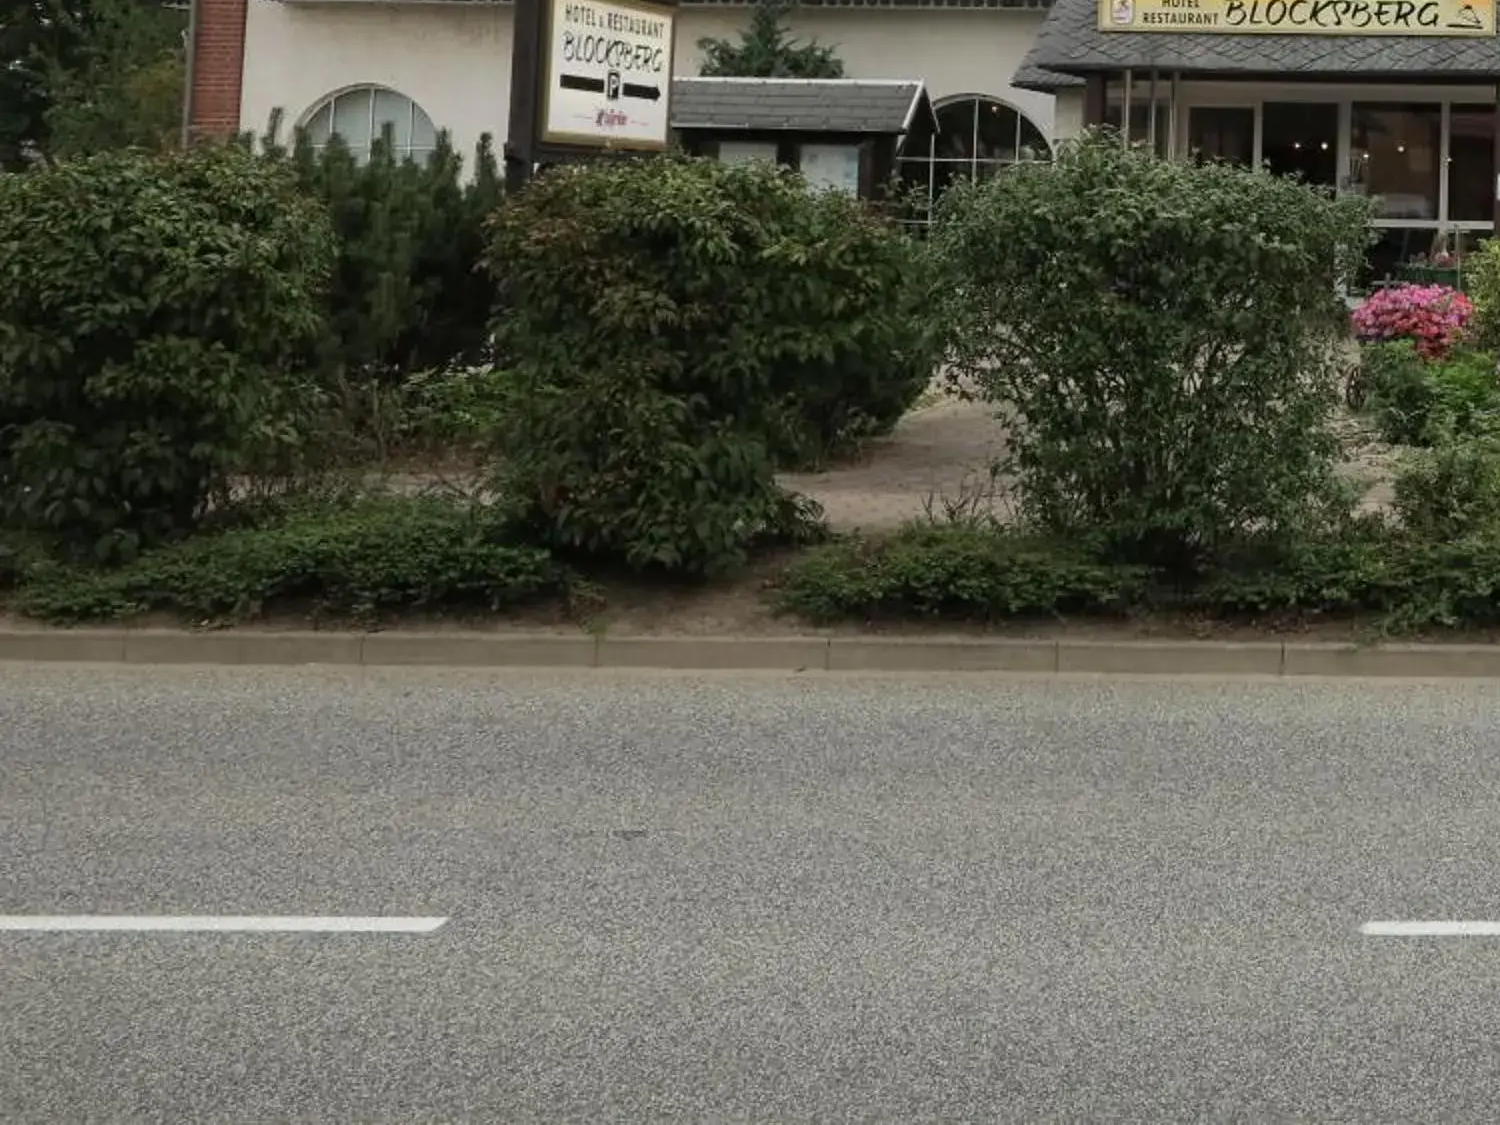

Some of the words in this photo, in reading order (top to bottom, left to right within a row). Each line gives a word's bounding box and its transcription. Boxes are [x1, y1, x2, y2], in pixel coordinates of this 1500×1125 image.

[565, 2, 596, 27] HOTEL
[607, 11, 665, 40] RESTAURANT
[1142, 12, 1219, 25] RESTAURANT
[562, 31, 663, 72] BLOCKSBERG
